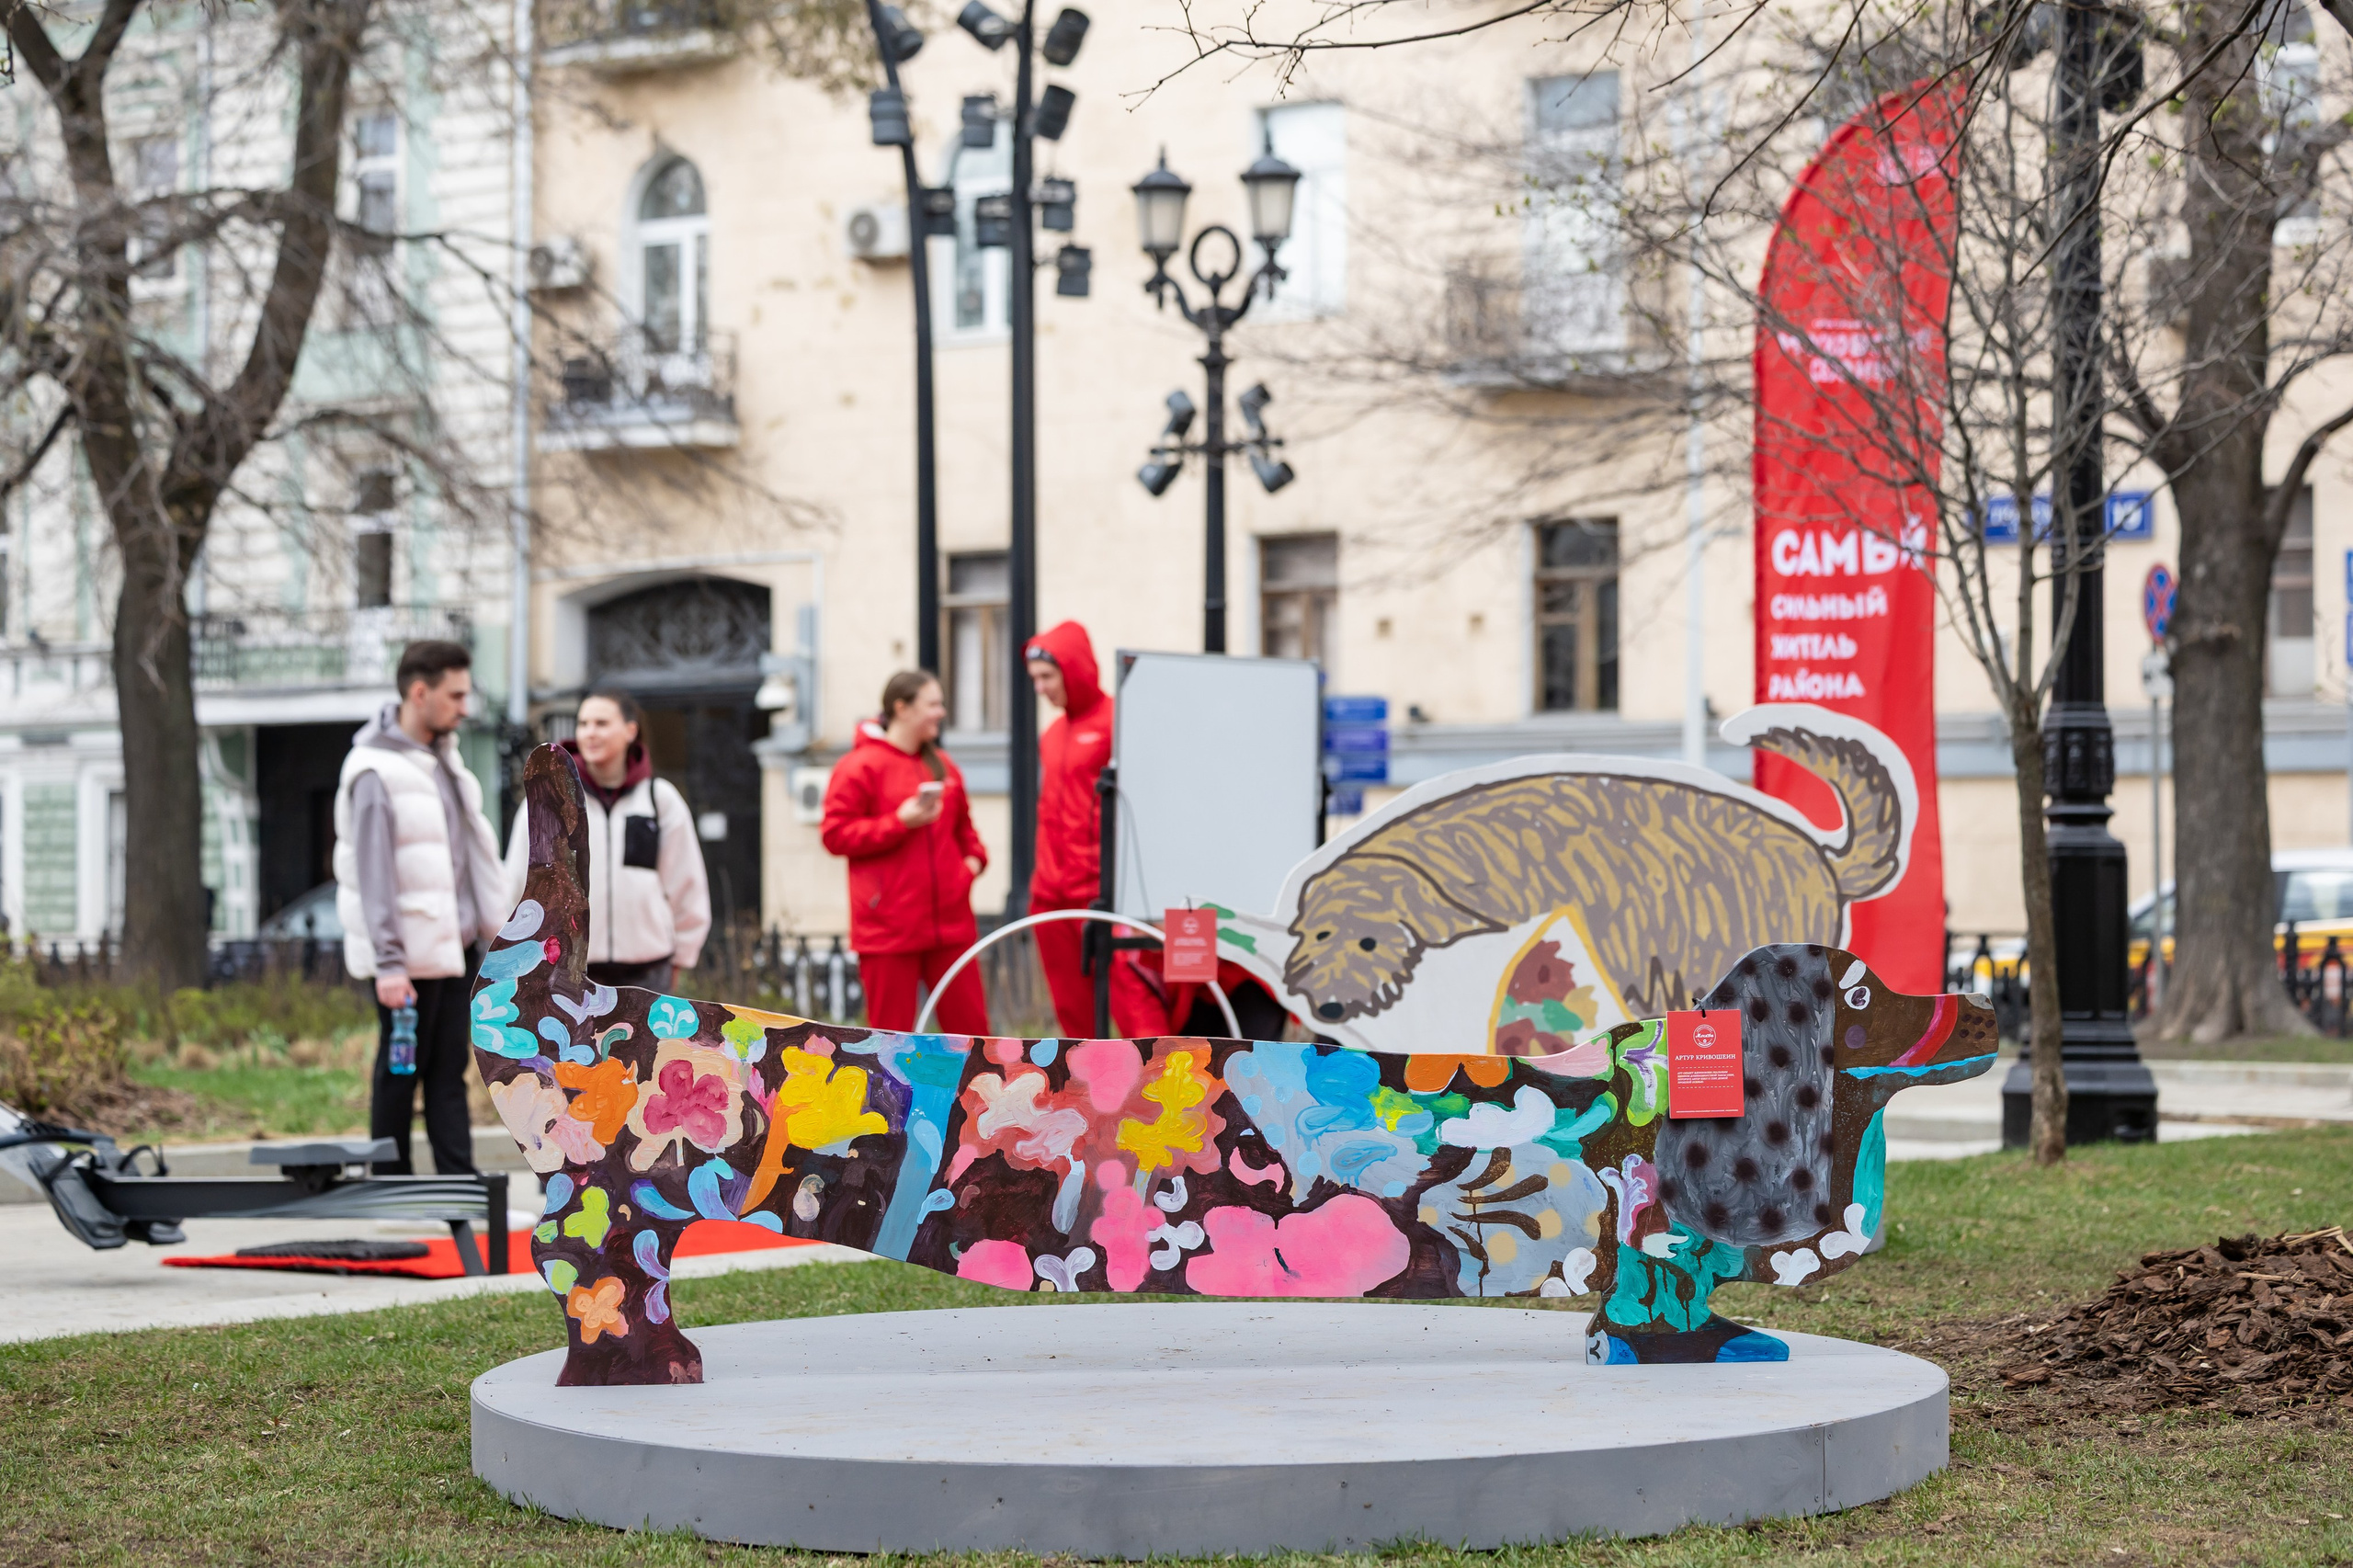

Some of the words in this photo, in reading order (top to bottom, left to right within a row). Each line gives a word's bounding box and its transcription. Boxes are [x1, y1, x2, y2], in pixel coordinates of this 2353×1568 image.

[1770, 585, 1888, 620] СИЛЬНЫЙ
[1770, 632, 1859, 660] ЖИТЕЛЬ
[1768, 667, 1866, 699] РАЙОНА
